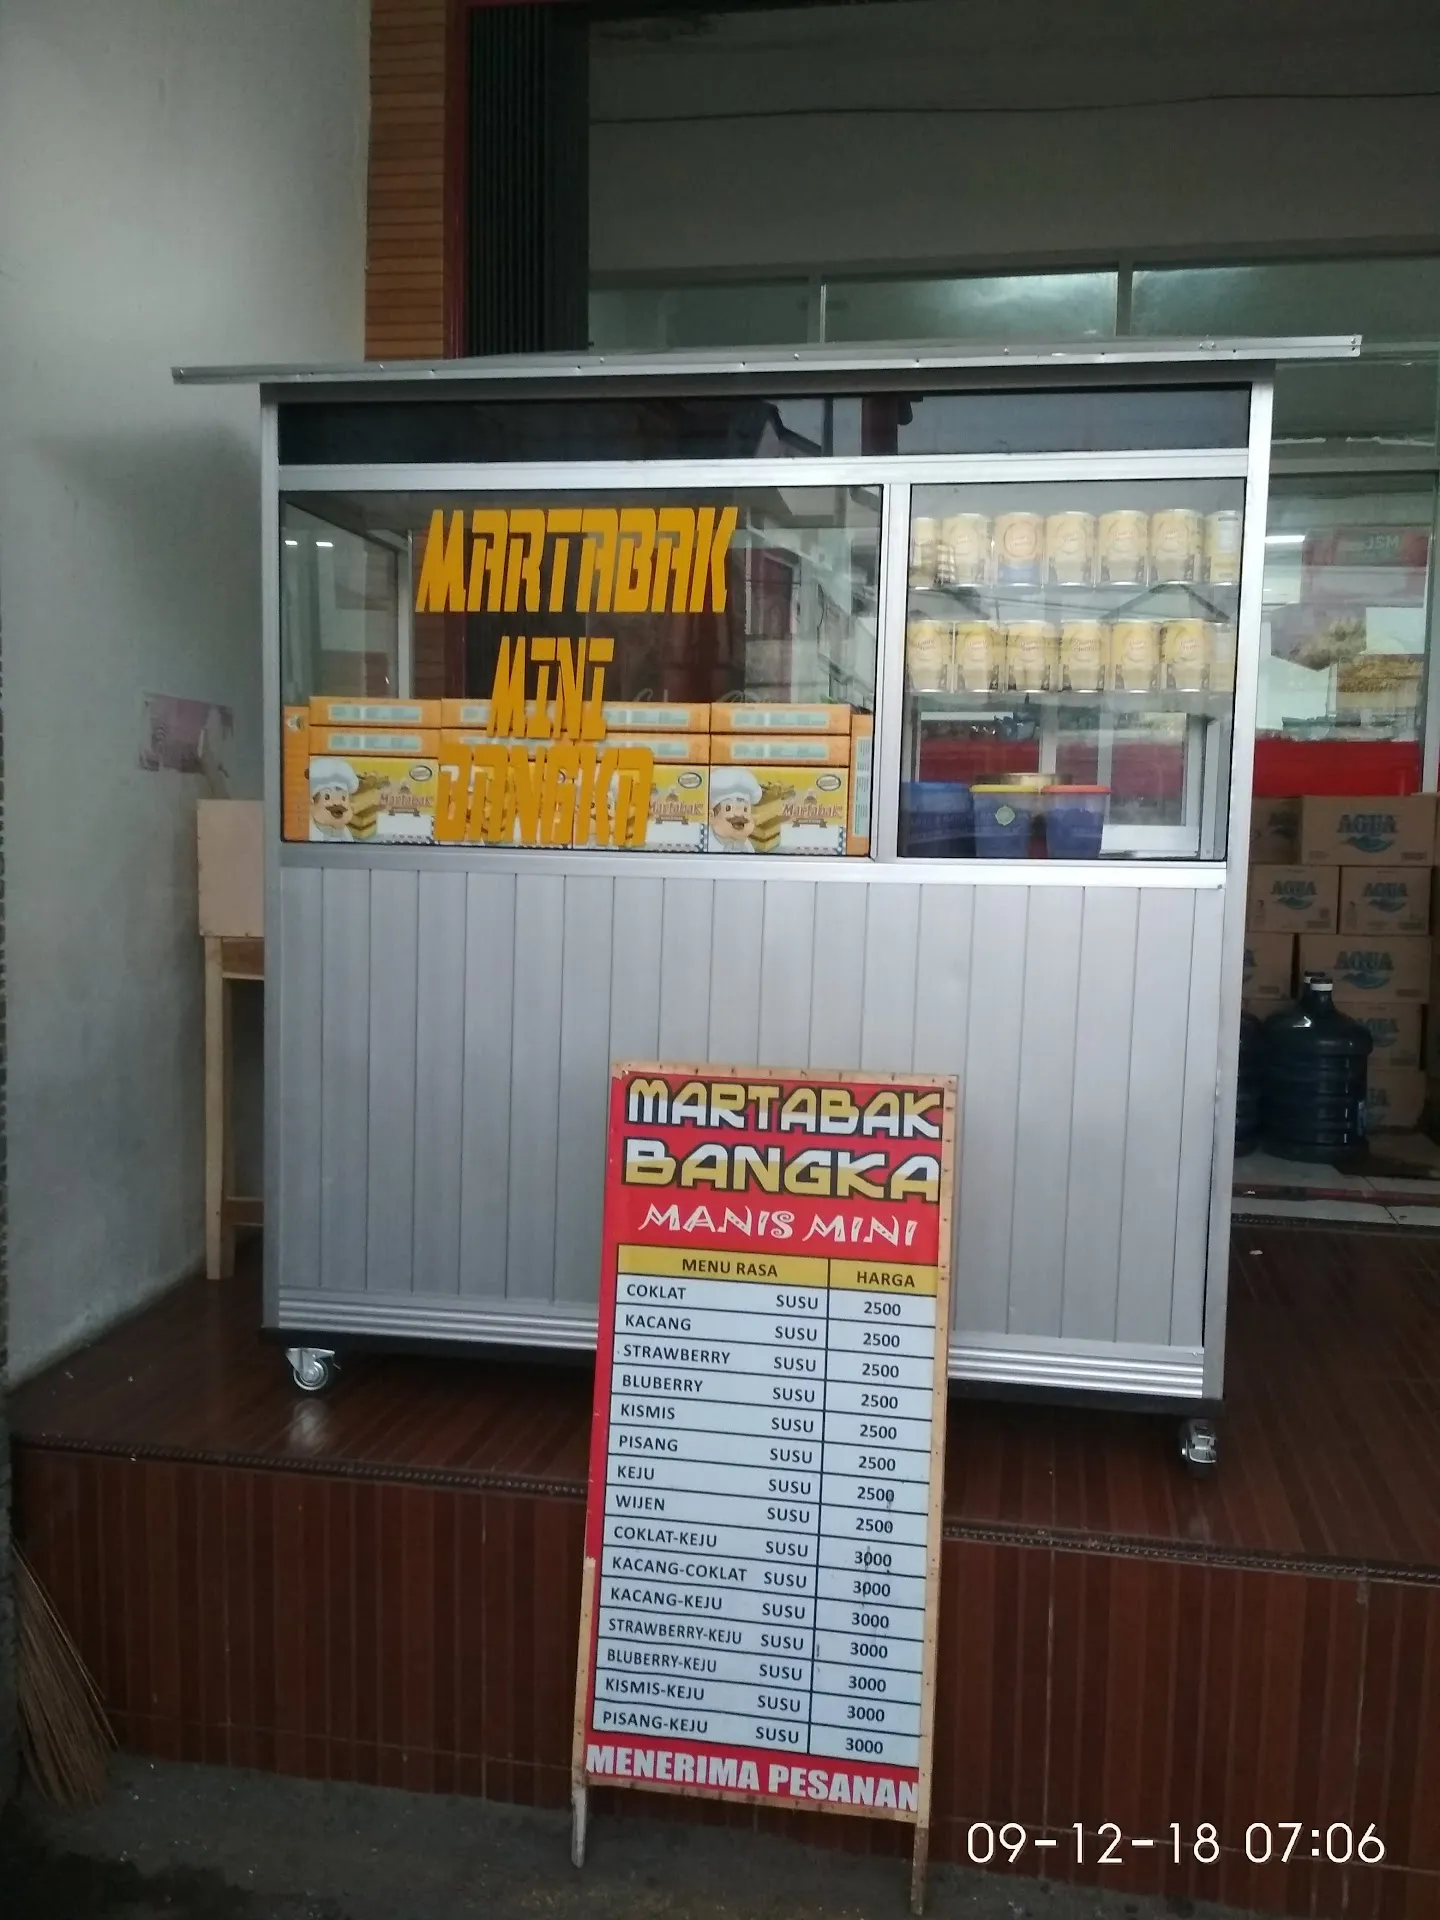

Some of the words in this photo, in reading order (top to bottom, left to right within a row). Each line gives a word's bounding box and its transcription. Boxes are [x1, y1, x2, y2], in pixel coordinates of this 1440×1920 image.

[415, 507, 737, 613] MARTABAK
[486, 636, 614, 740] MINI
[783, 804, 842, 818] Martabak
[1337, 814, 1398, 837] AQUA
[1271, 881, 1317, 896] AQUA
[1363, 883, 1409, 898] AQUA
[1334, 951, 1394, 971] AQUA
[626, 1077, 943, 1138] MARTABAK
[624, 1139, 940, 1202] BANGKA
[638, 1203, 795, 1239] MANIS
[802, 1214, 918, 1247] MINI
[682, 1258, 731, 1275] MENU
[736, 1262, 778, 1278] RASA
[856, 1270, 916, 1288] HARGA
[626, 1283, 687, 1300] COKLAT
[775, 1294, 819, 1310] SUSU
[863, 1301, 902, 1317] 2500
[625, 1314, 691, 1332] KACANG
[774, 1325, 818, 1342] SUSU
[862, 1332, 901, 1348] 2500
[623, 1344, 731, 1365] STRAWBERRY
[773, 1356, 817, 1373] SUSU
[861, 1362, 900, 1379] 2500
[622, 1374, 704, 1393] BLUBERRY
[772, 1386, 815, 1403] SUSU
[860, 1393, 899, 1410] 2500
[620, 1403, 676, 1420] KISMIS
[771, 1416, 814, 1433] SUSU
[859, 1423, 898, 1440] 2500
[619, 1435, 678, 1453] PISANG
[769, 1447, 813, 1464] SUSU
[858, 1455, 896, 1472] 2500
[617, 1465, 655, 1481] KEJU
[768, 1478, 811, 1495] SUSU
[856, 1485, 895, 1503] 2500
[615, 1494, 665, 1512] WIJEN
[766, 1506, 810, 1524] SUSU
[855, 1517, 894, 1534] 2500
[613, 1526, 717, 1548] COKLAT-KEJU
[765, 1540, 809, 1558] SUSU
[854, 1550, 893, 1568] 3000
[612, 1556, 748, 1582] KACANG-COKLAT
[763, 1571, 807, 1589] SUSU
[852, 1580, 891, 1598] 3000
[610, 1587, 723, 1611] KACANG-KEJU
[761, 1602, 806, 1620] SUSU
[851, 1611, 890, 1629] 3000
[608, 1618, 742, 1645] STRAWBERRY-KEJU
[760, 1633, 804, 1651] SUSU
[850, 1641, 888, 1659] 3000
[607, 1648, 717, 1673] BLUBERRY-KEJU
[759, 1663, 803, 1681] SUSU
[848, 1675, 887, 1693] 3000
[605, 1677, 705, 1701] KISMIS-KEJU
[757, 1694, 801, 1713] SUSU
[846, 1705, 885, 1722] 3000
[603, 1710, 708, 1734] PISANG-KEJU
[755, 1726, 799, 1744] SUSU
[845, 1737, 884, 1755] 3000
[586, 1744, 760, 1790] MENERIMA
[768, 1763, 919, 1812] PESANAN
